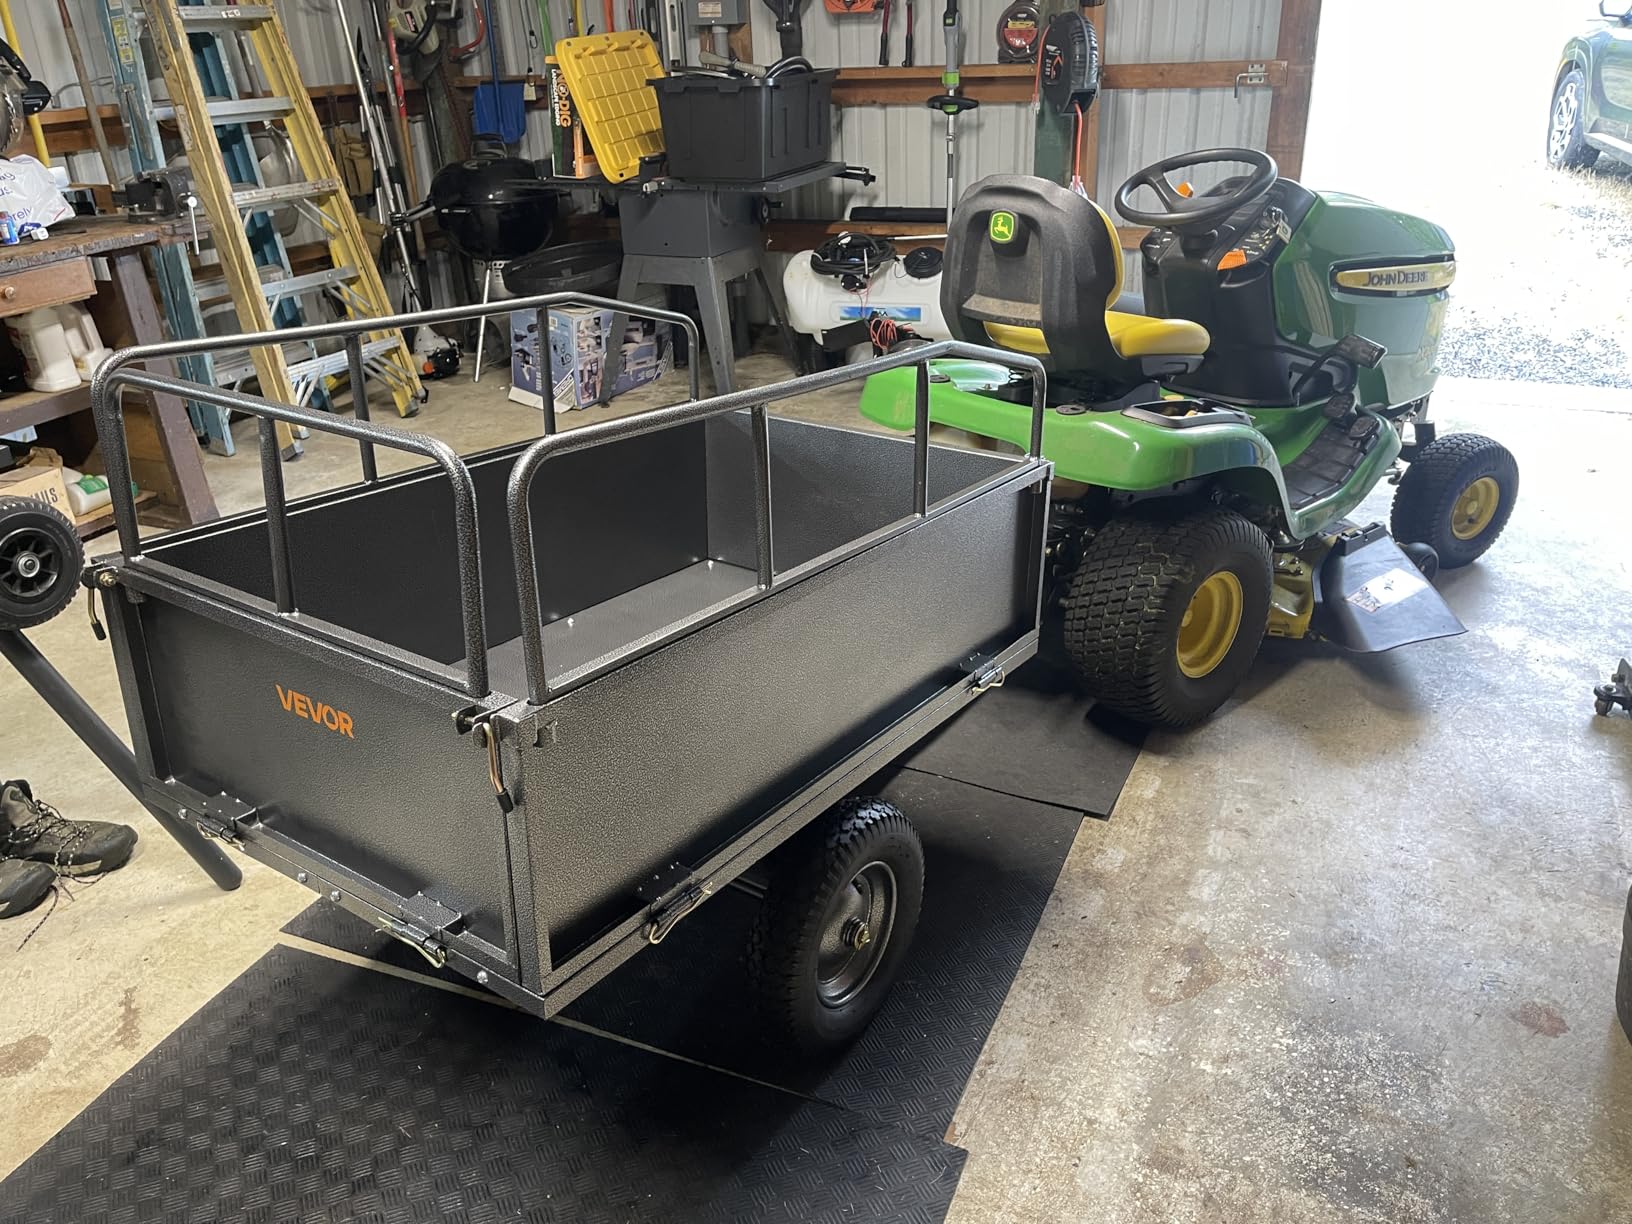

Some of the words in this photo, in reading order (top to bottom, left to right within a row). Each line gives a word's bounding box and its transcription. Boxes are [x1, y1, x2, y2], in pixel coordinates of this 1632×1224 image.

[551, 69, 559, 102] LANDSCAPE
[1363, 271, 1397, 287] JOHN
[1398, 270, 1428, 284] DEERE
[275, 684, 355, 739] VEVOR
